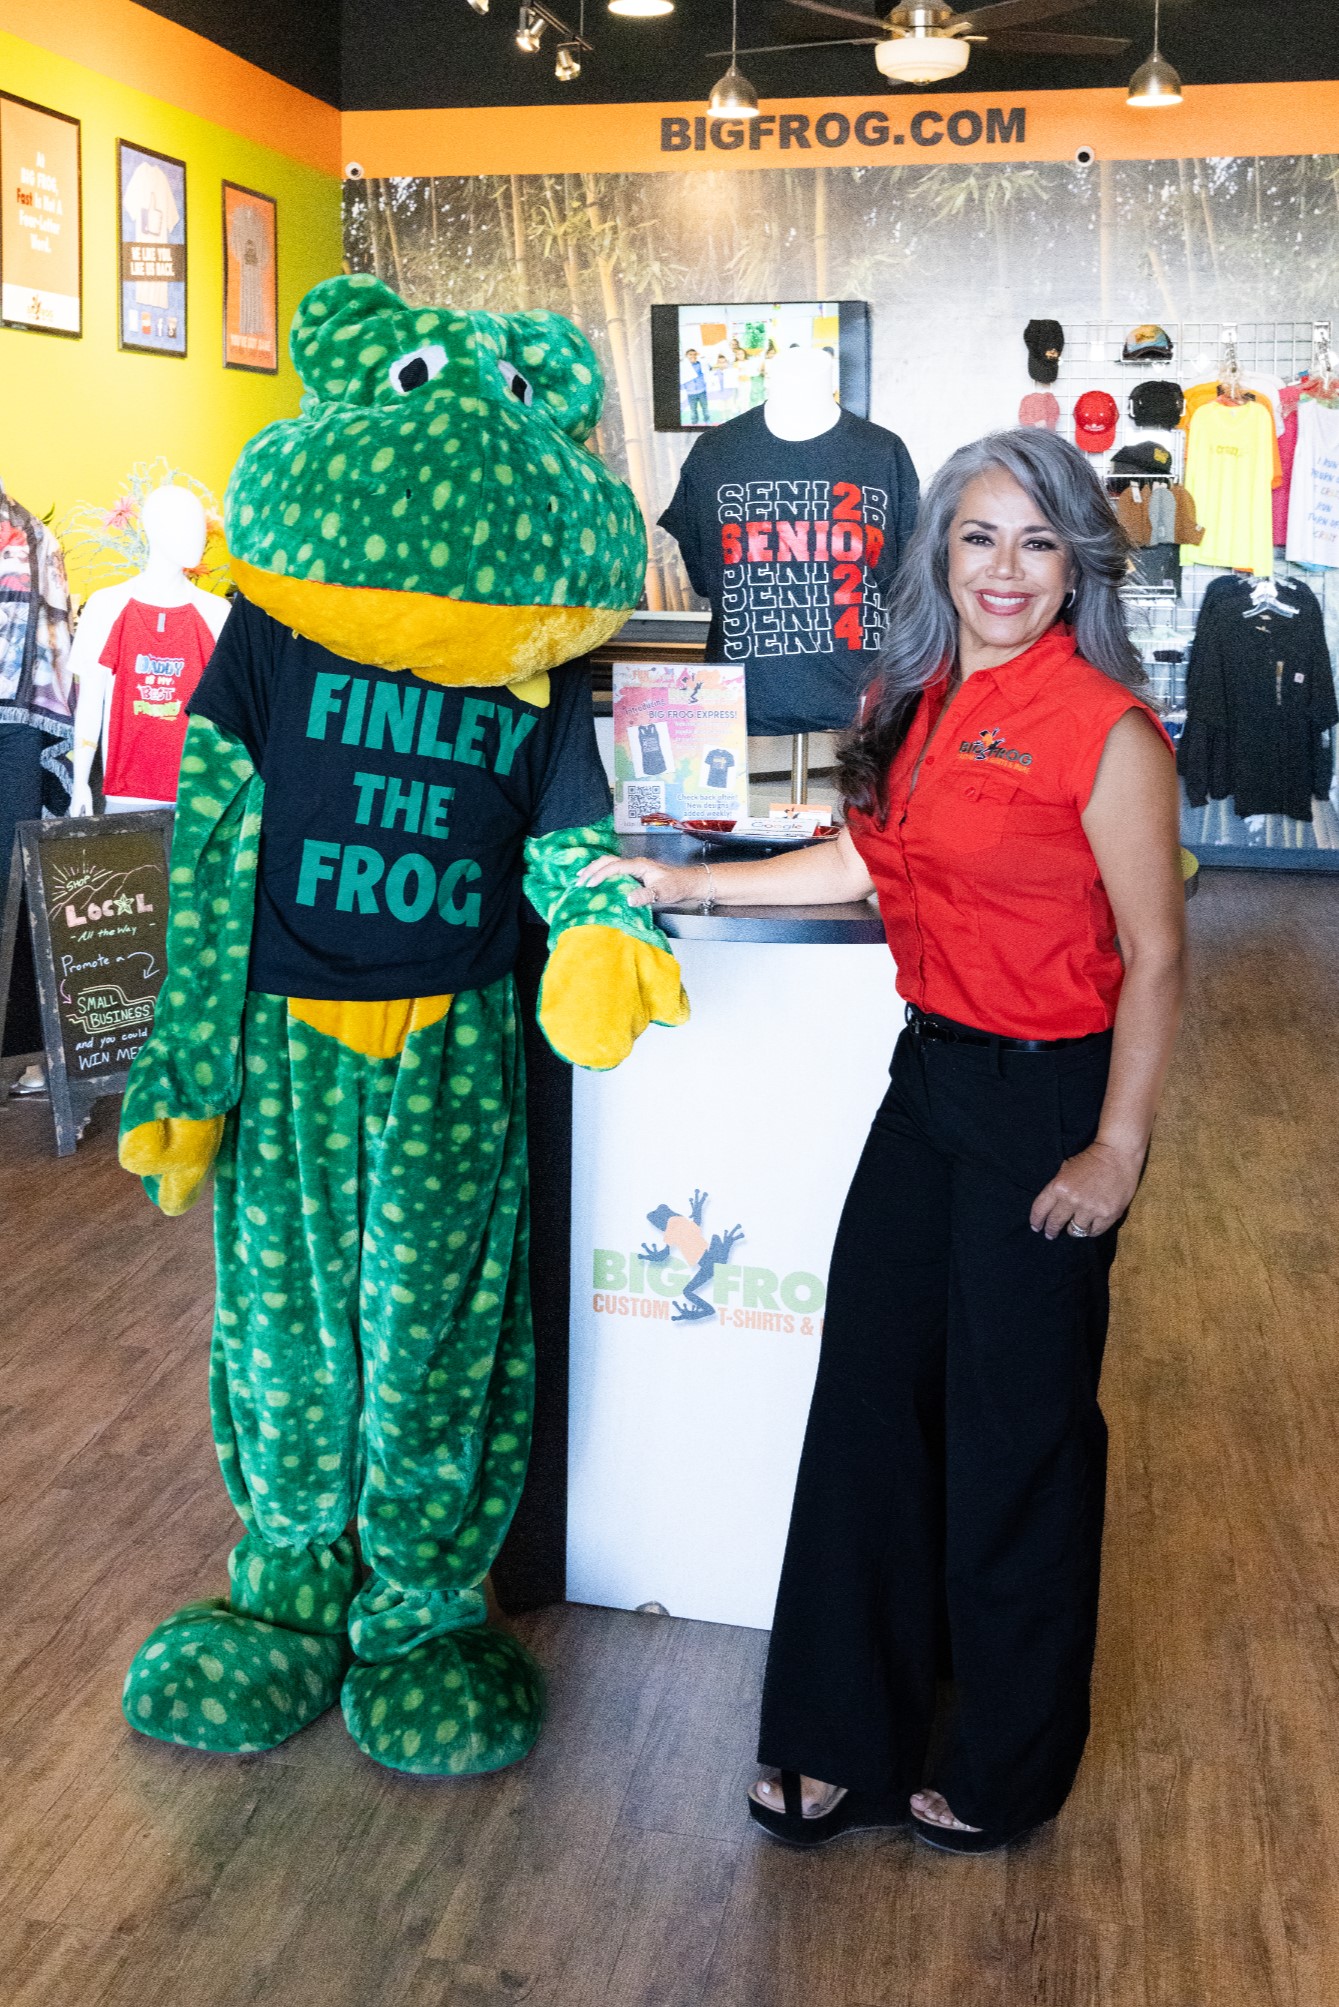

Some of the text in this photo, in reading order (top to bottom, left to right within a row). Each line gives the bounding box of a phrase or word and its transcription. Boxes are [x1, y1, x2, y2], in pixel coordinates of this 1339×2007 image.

[660, 107, 1026, 152] BIGFROG.COM
[17, 187, 32, 206] Fast
[721, 520, 885, 569] SENIOR
[135, 654, 185, 677] DADDY
[139, 685, 176, 701] BEST
[306, 671, 539, 776] FINLEY
[648, 710, 737, 719] BIG FROG EXPRESS!
[353, 771, 456, 840] THE
[751, 821, 803, 831] Google
[66, 875, 91, 892] SHOP
[296, 838, 482, 928] FROG
[97, 928, 116, 938] the
[117, 924, 137, 936] Way
[61, 953, 110, 976] Promote
[77, 994, 118, 1014] SMALL
[89, 1004, 150, 1028] BUSINESS
[75, 1027, 148, 1051] and you could
[78, 1051, 110, 1071] WIN
[592, 1248, 692, 1298] BIG
[592, 1293, 671, 1321] CUSTOM
[717, 1307, 796, 1335] T-SHIRTS
[800, 1316, 815, 1336] &
